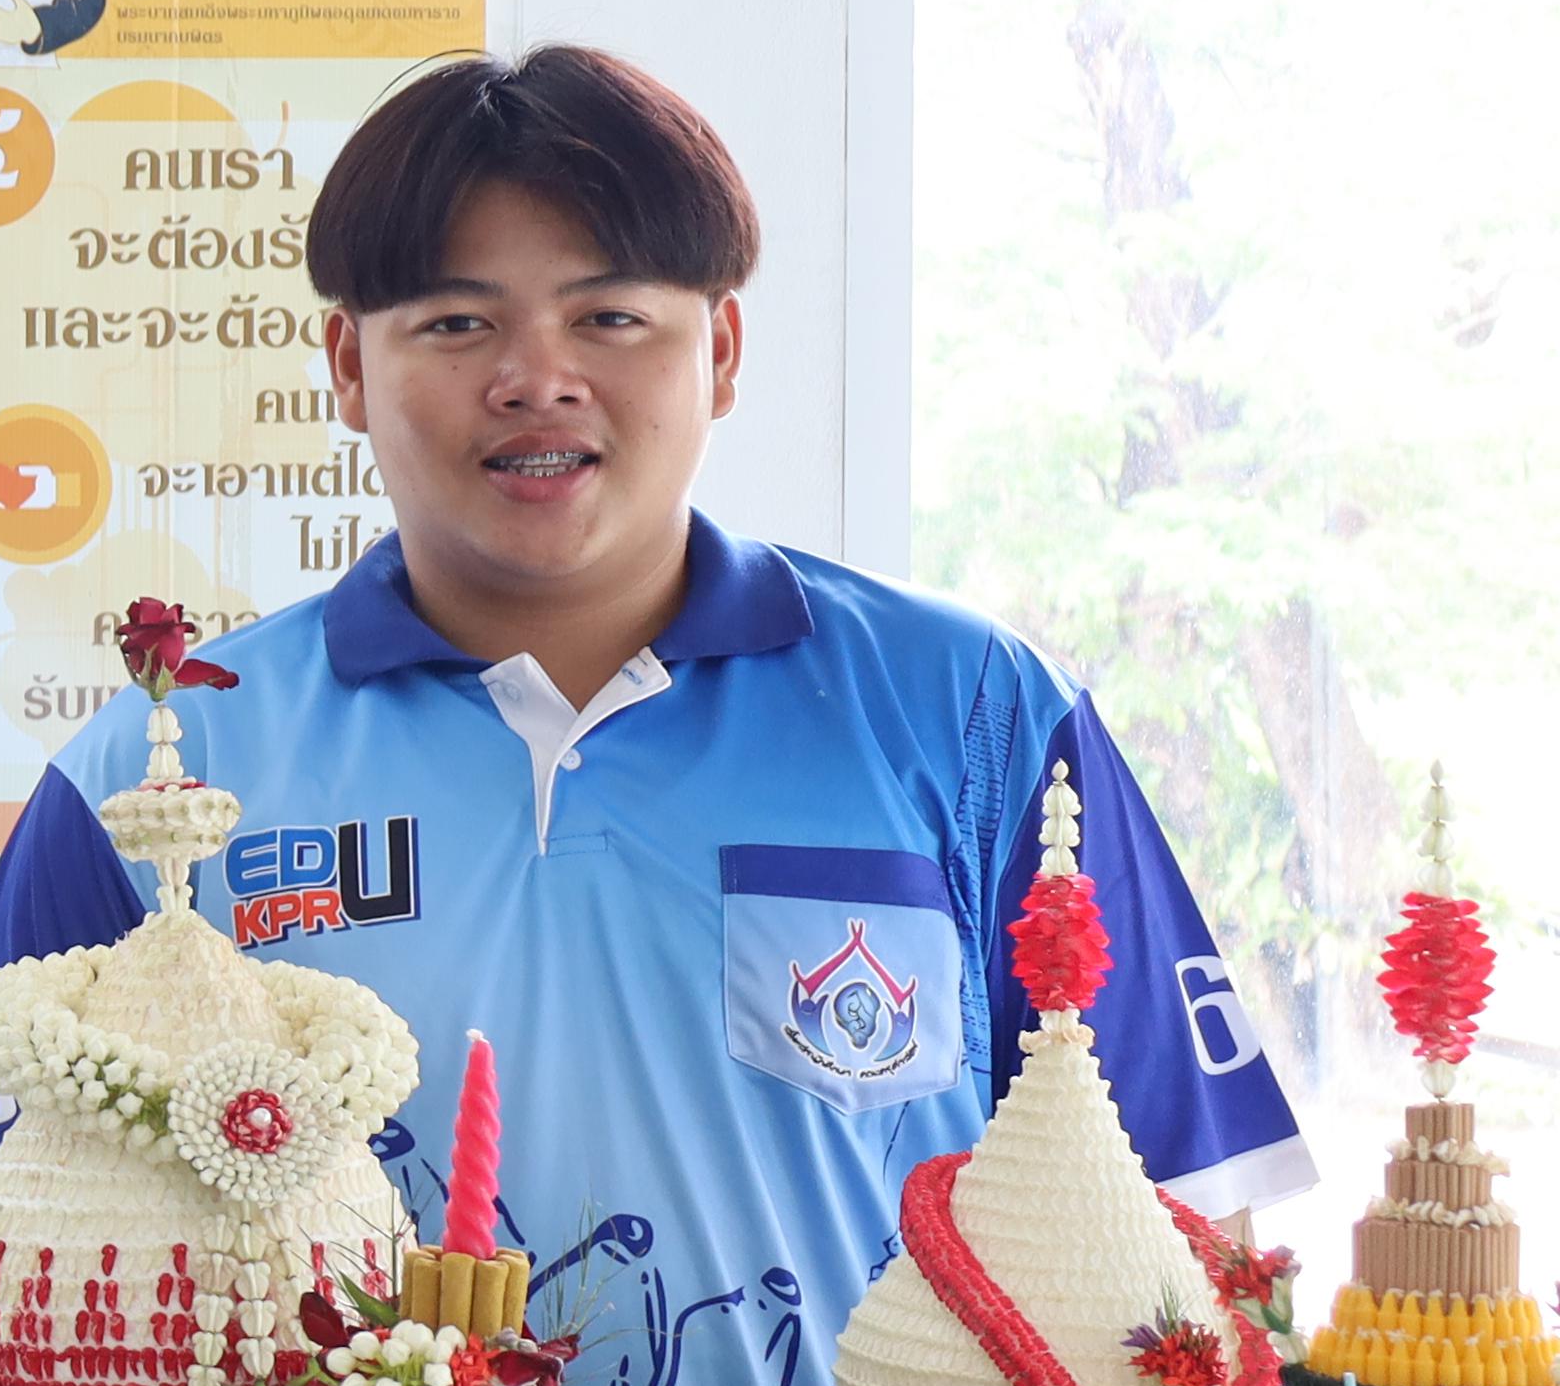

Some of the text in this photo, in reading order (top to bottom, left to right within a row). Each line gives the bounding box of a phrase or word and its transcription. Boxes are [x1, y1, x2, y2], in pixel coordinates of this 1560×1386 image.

[122, 148, 297, 192] คนเรา
[69, 213, 310, 270] จะต้องรั
[223, 814, 421, 926] EDU
